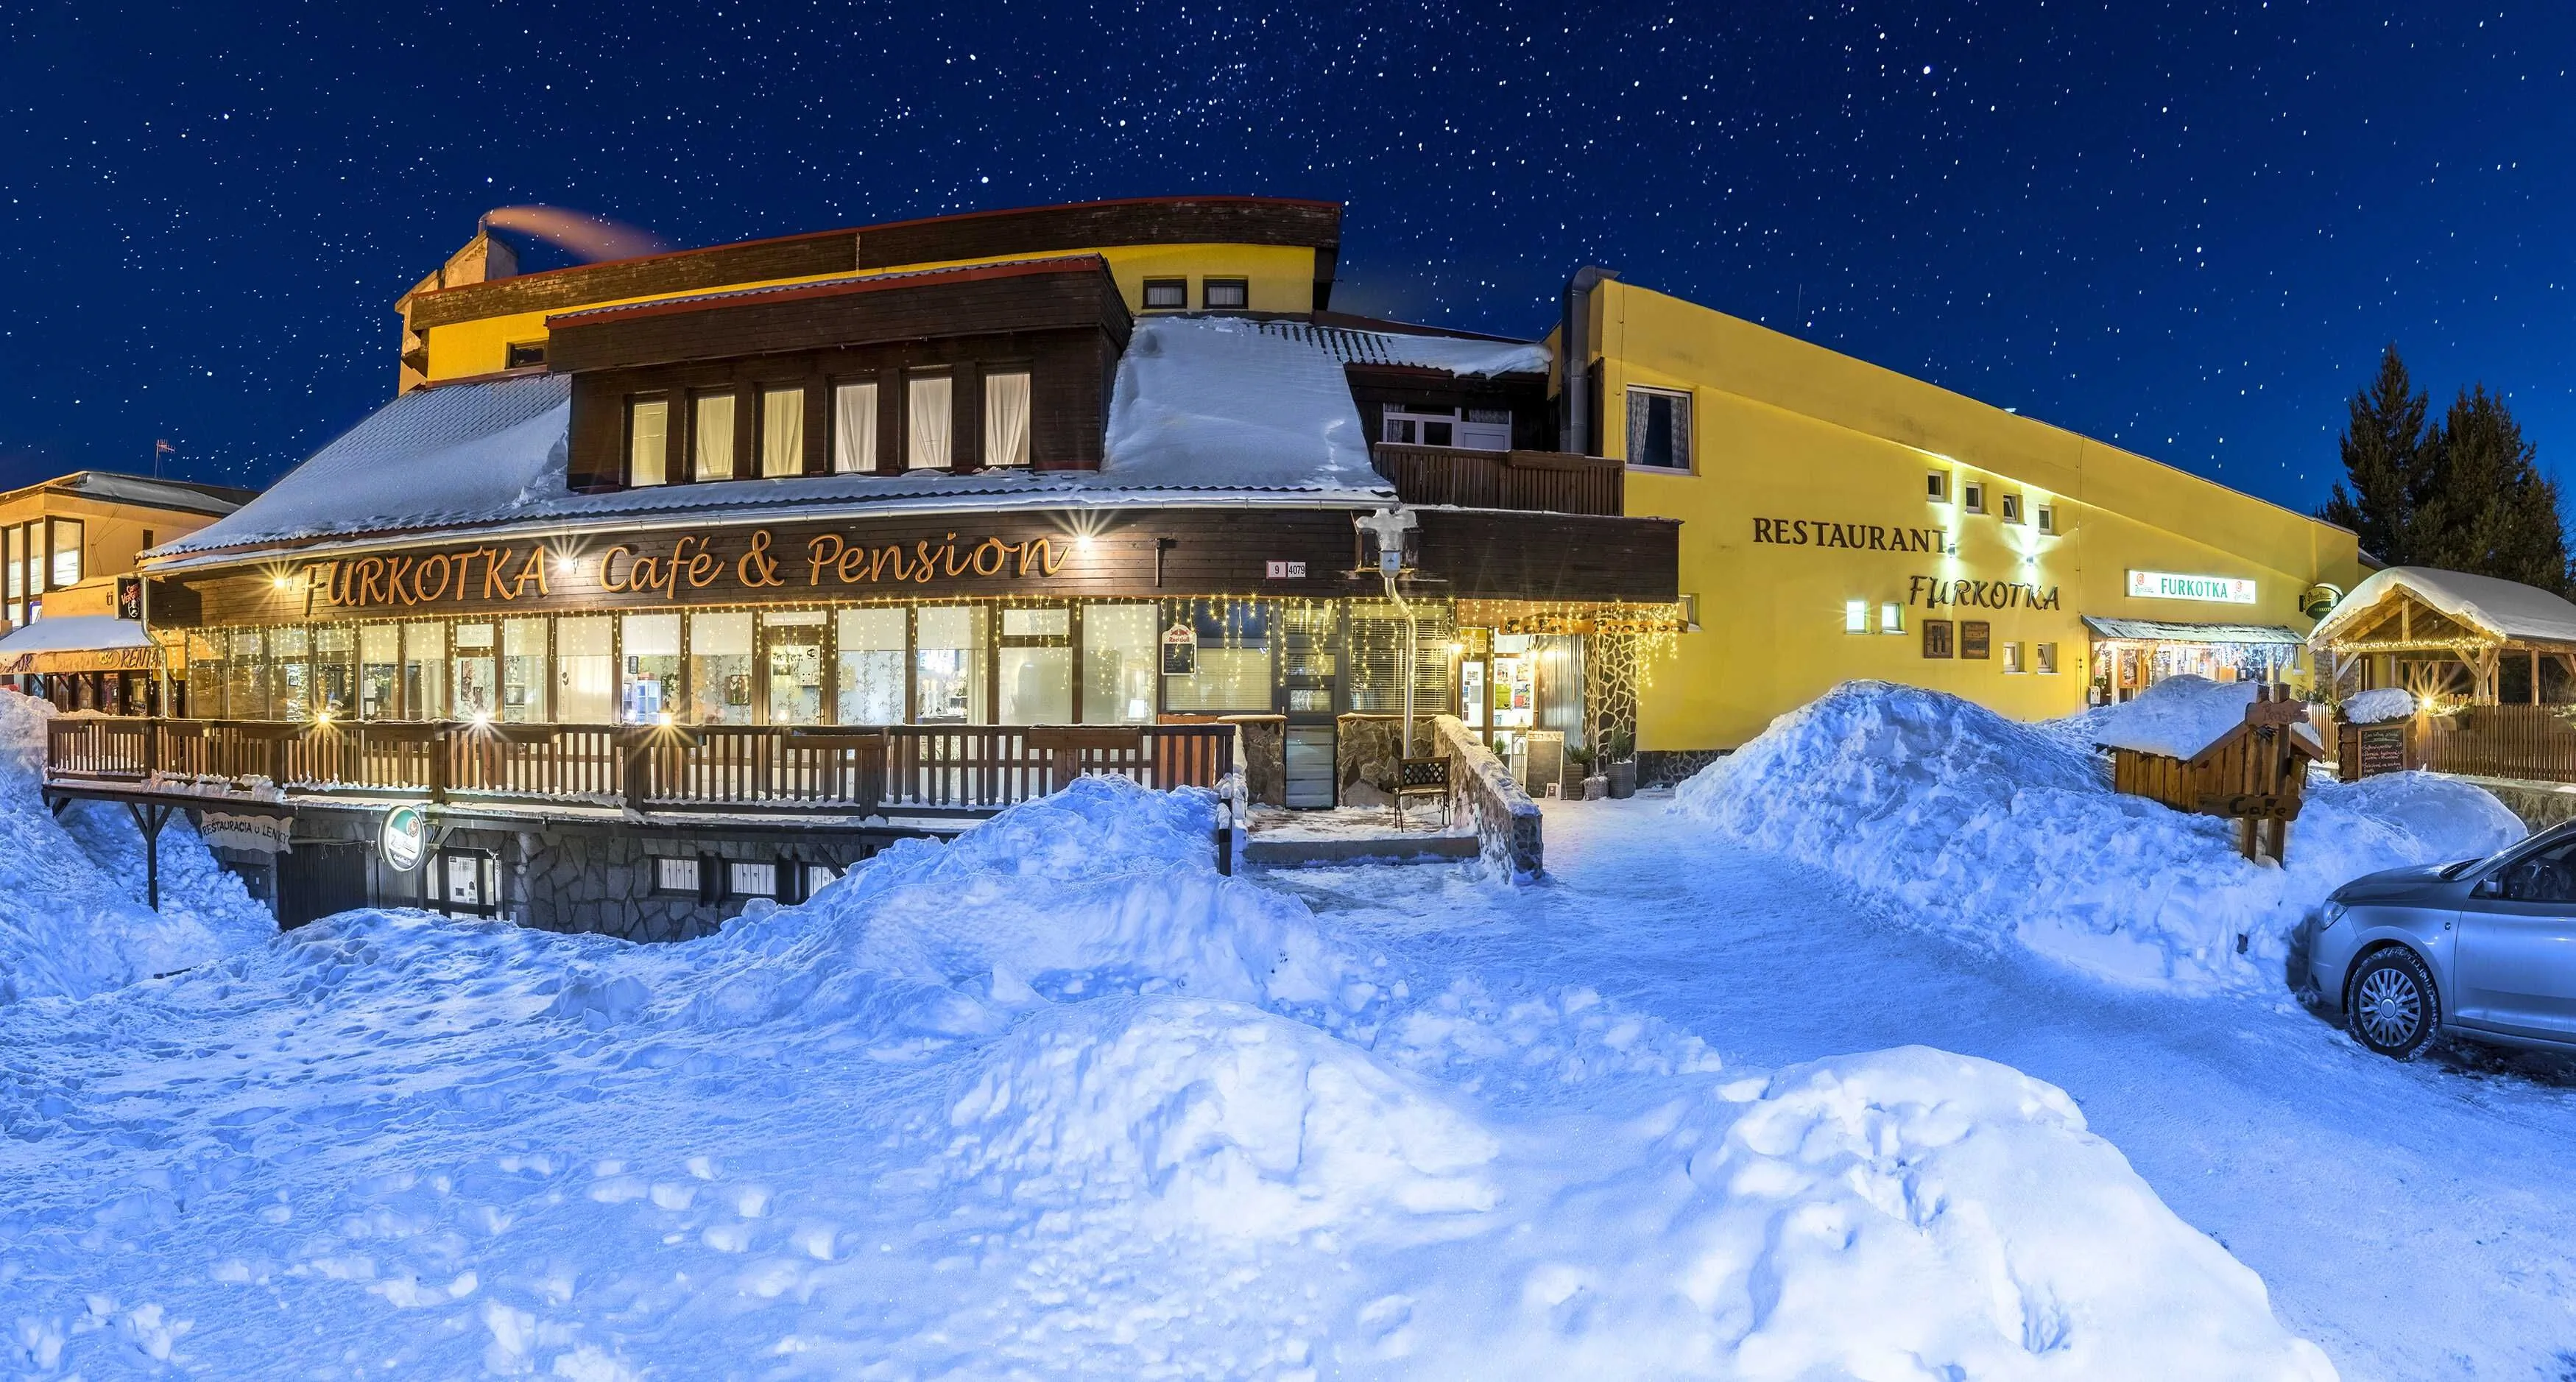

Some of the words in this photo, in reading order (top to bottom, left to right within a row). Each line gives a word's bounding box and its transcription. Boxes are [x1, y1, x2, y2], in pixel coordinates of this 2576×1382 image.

[1753, 518, 1947, 553] RESTAURANT
[300, 545, 550, 617] FURKOTKA
[599, 536, 725, 599] Café
[738, 529, 785, 588] &
[808, 532, 1071, 586] Pension
[1274, 565, 1280, 574] 9
[1288, 565, 1305, 574] 4079
[1910, 576, 2060, 610] FURKOTKA
[2161, 577, 2228, 598] FURKOTKA
[121, 648, 162, 668] RENTA
